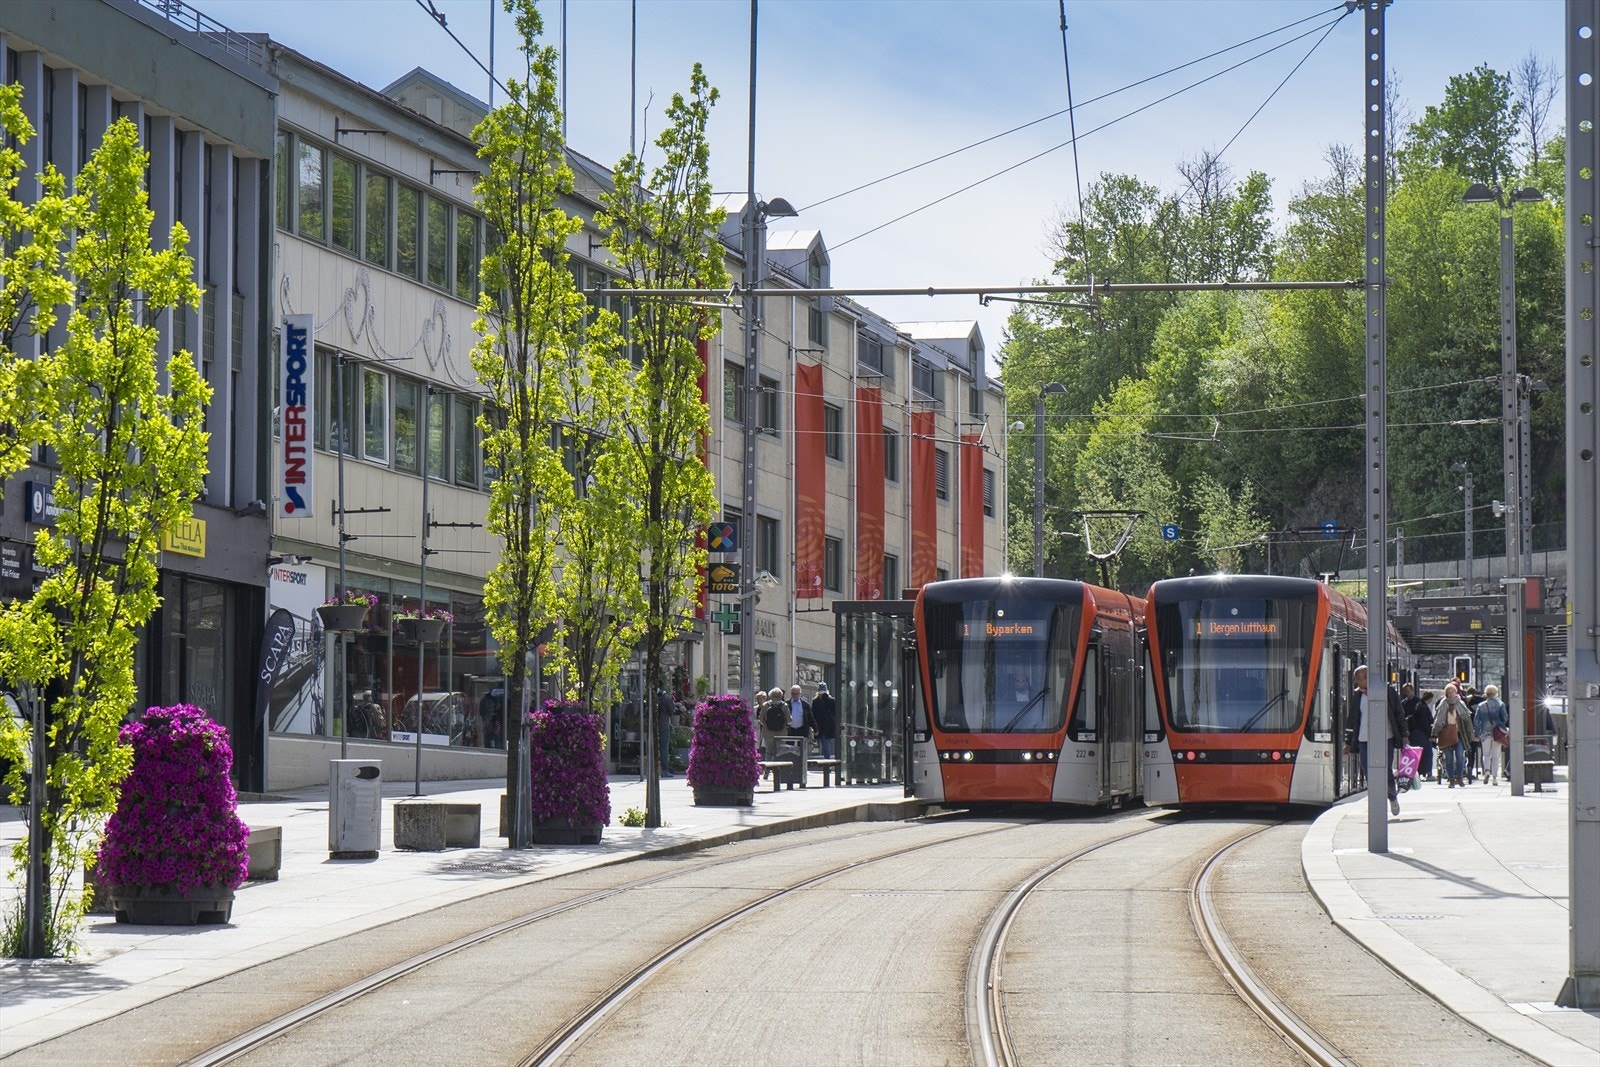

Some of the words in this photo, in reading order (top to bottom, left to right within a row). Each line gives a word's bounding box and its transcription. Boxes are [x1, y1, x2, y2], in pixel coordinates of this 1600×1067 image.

[285, 323, 307, 484] INTERSPORT
[1166, 527, 1175, 538] S
[274, 568, 307, 586] INTERSPORT
[712, 583, 735, 591] TOTO
[963, 624, 969, 636] 1
[986, 623, 1033, 636] Byparken
[1196, 622, 1202, 635] 1
[1210, 622, 1240, 636] Bergen
[261, 625, 290, 684] SCAPA
[1076, 750, 1087, 758] 222
